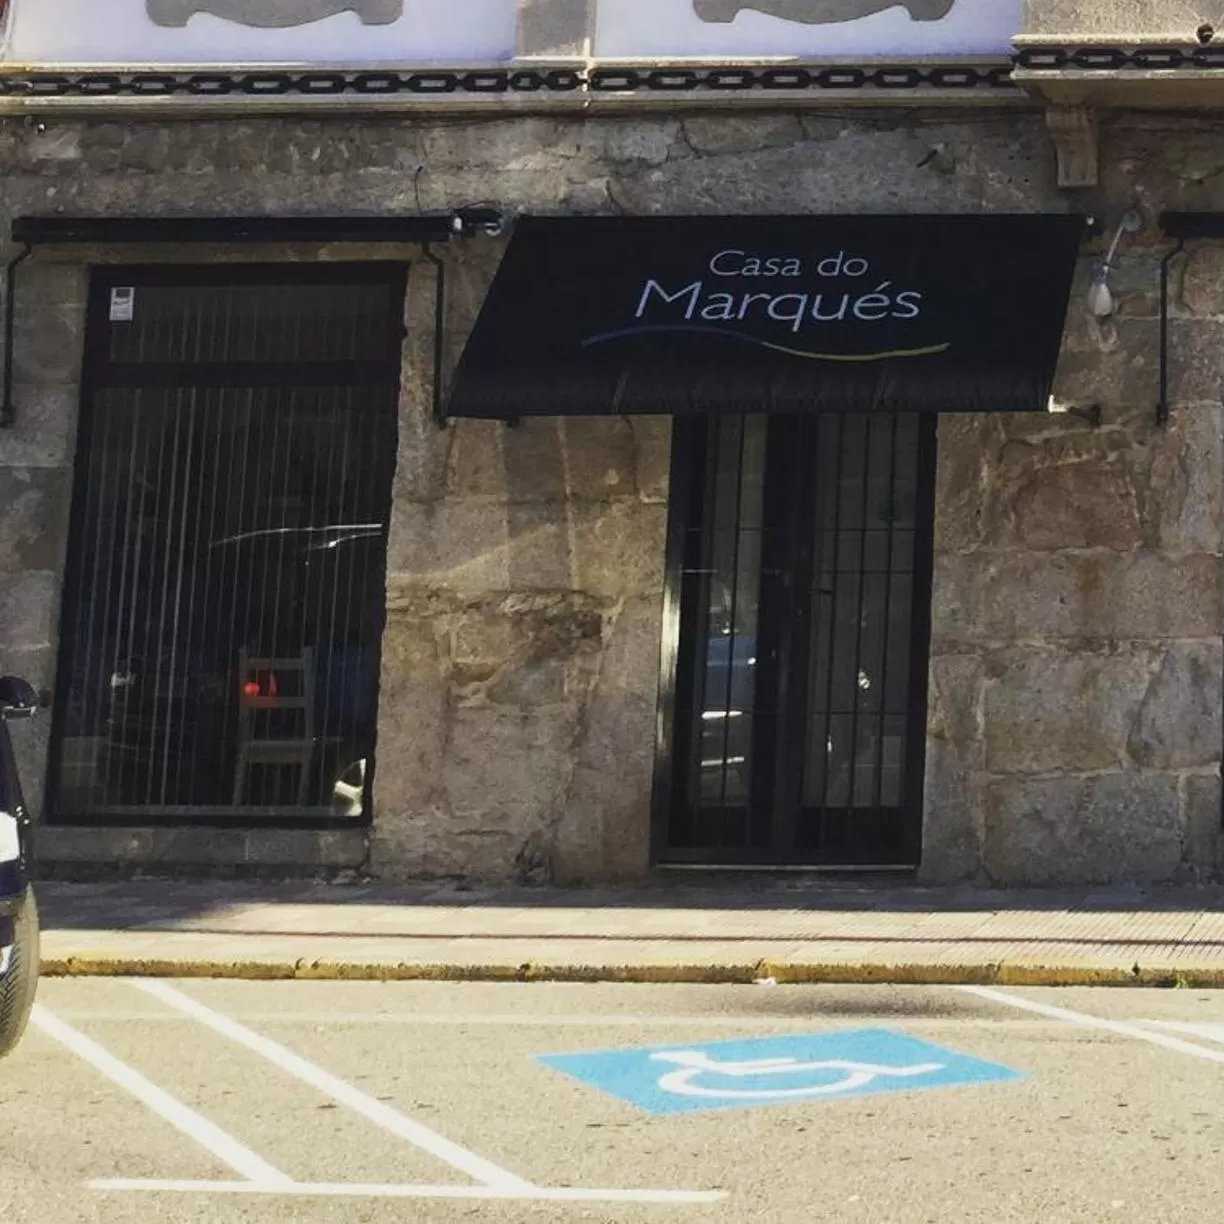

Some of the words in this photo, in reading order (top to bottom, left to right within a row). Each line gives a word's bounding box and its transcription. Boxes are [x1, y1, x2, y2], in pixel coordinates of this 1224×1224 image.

[710, 250, 801, 277] Casa
[817, 250, 868, 277] do
[635, 279, 921, 333] Marqués
